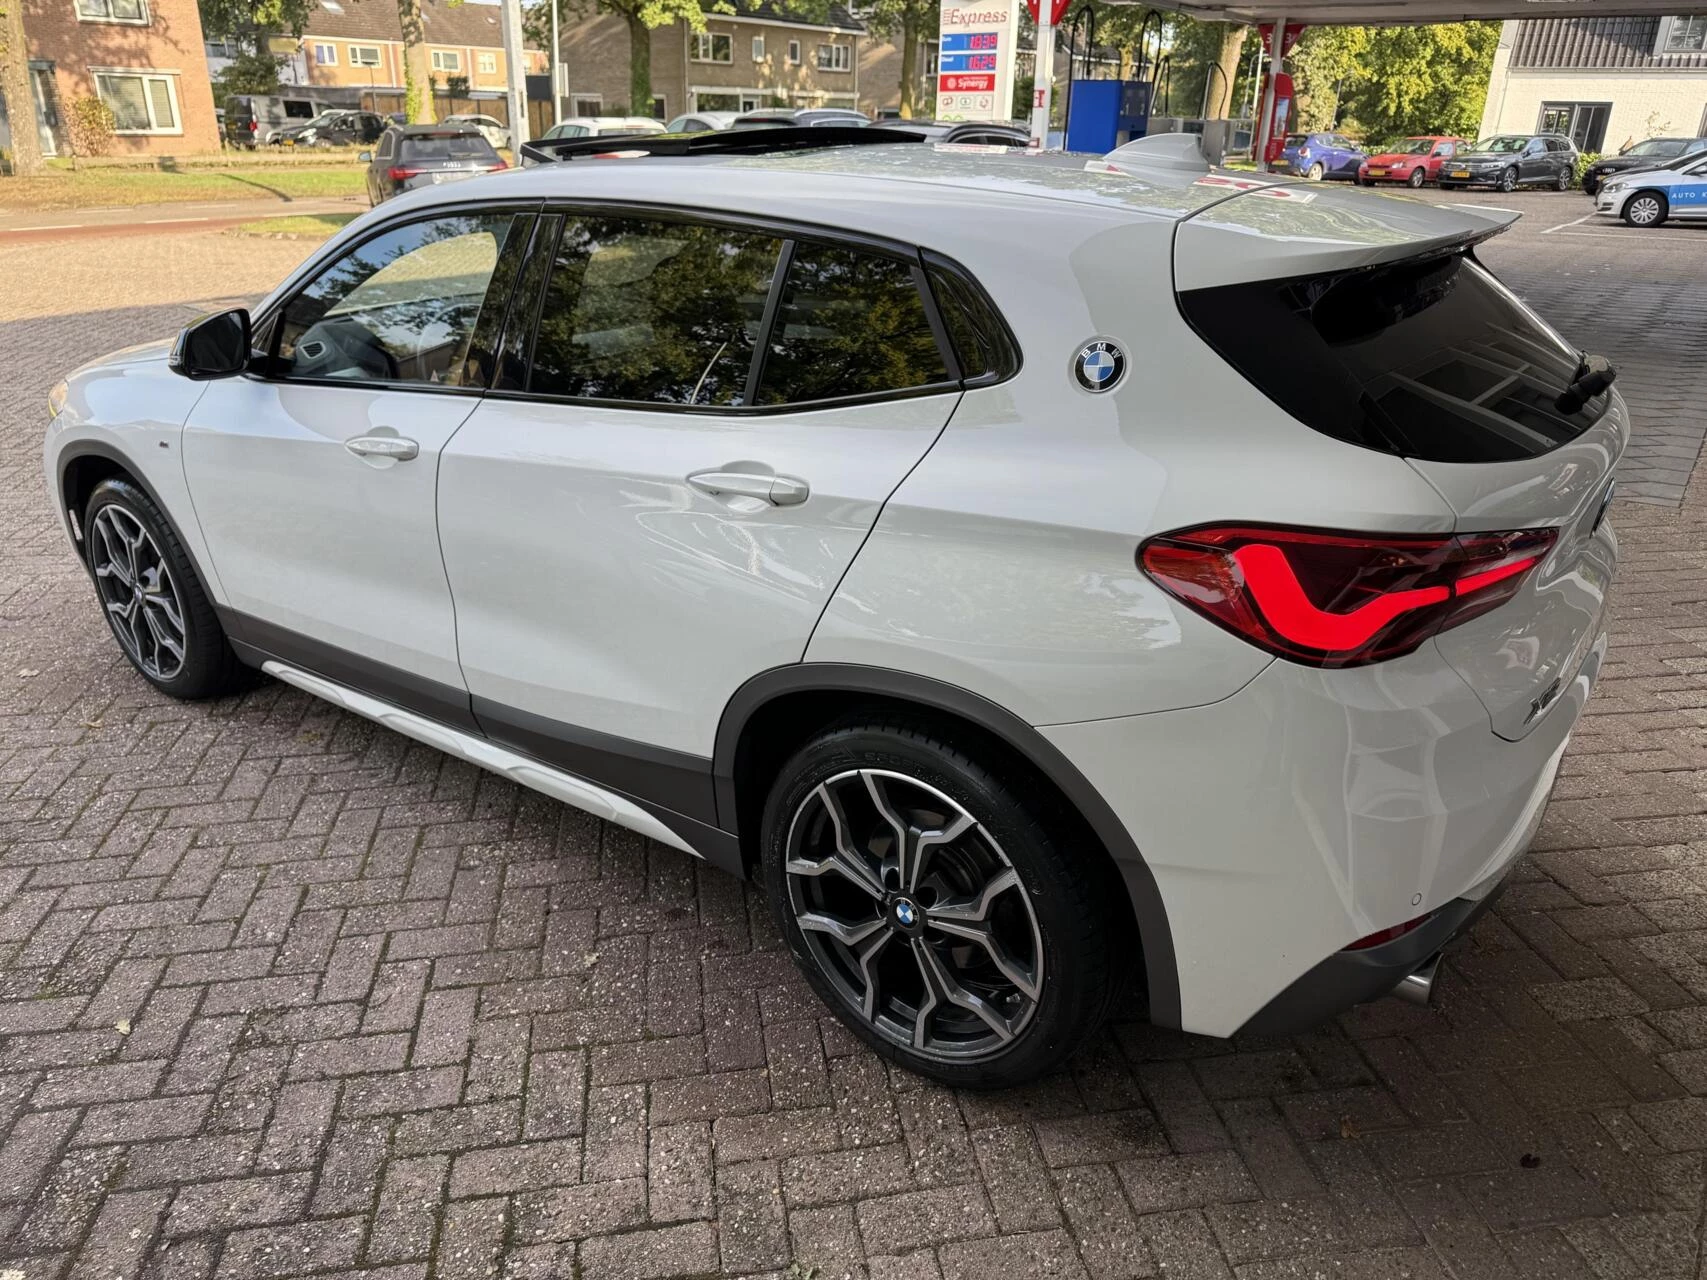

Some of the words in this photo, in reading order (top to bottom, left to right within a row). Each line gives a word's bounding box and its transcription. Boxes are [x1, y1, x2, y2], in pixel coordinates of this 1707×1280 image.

[951, 8, 1008, 27] Express
[958, 78, 988, 90] Synergy
[1671, 191, 1696, 199] AUTO
[1081, 342, 1122, 359] BMW
